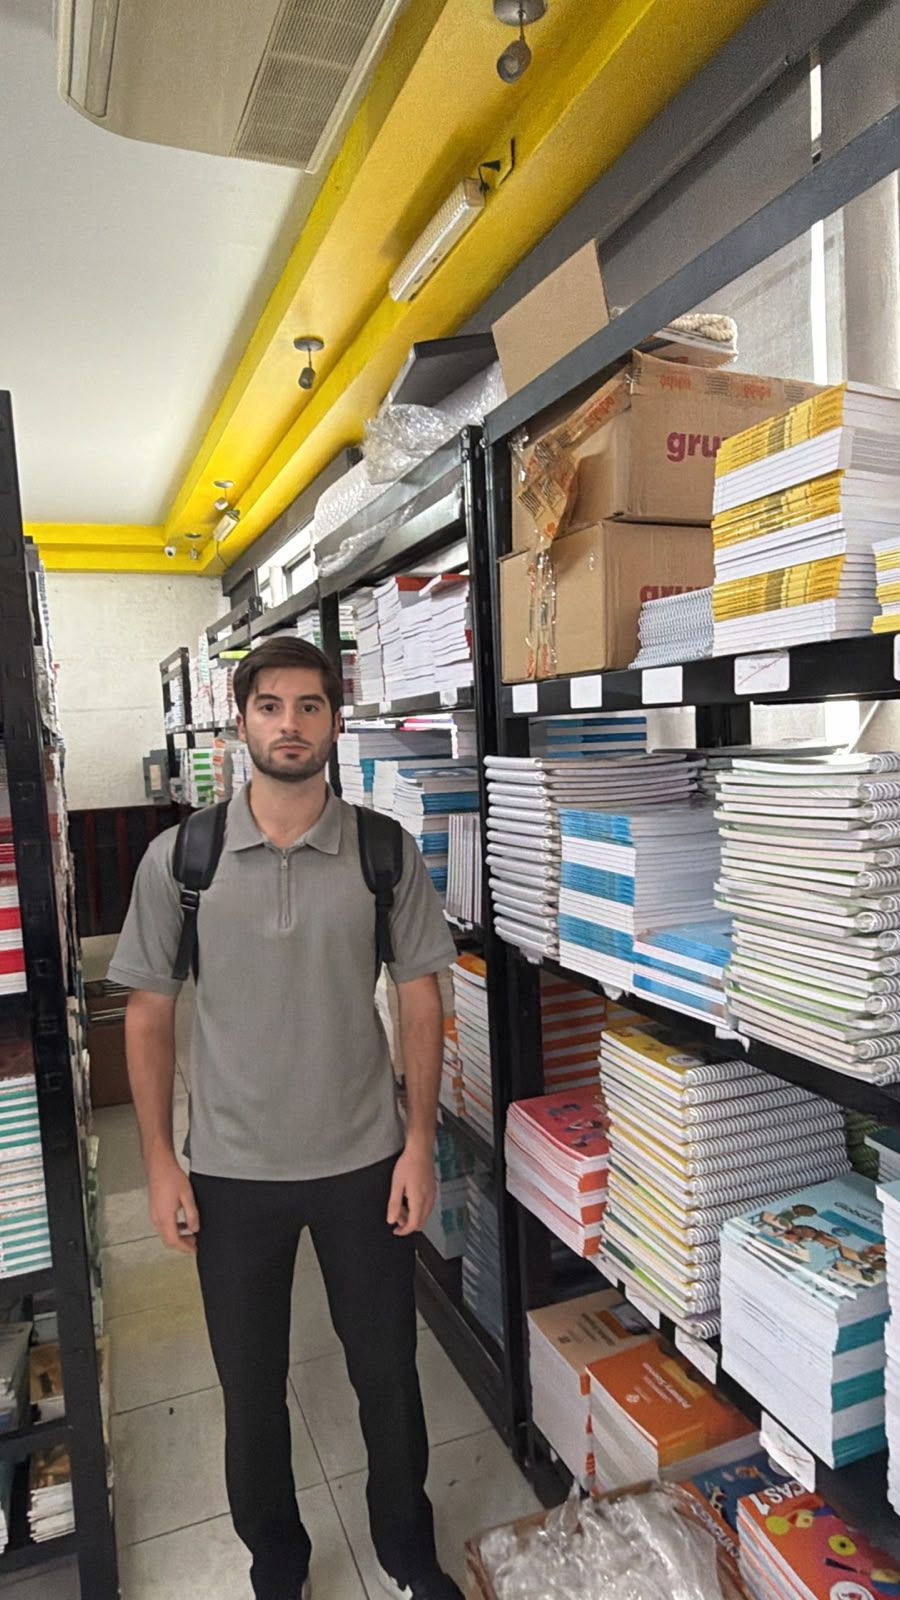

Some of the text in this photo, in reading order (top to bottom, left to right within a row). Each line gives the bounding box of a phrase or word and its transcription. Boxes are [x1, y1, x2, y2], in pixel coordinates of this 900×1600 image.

[667, 432, 721, 462] gru
[748, 1480, 806, 1516] CAS 1
